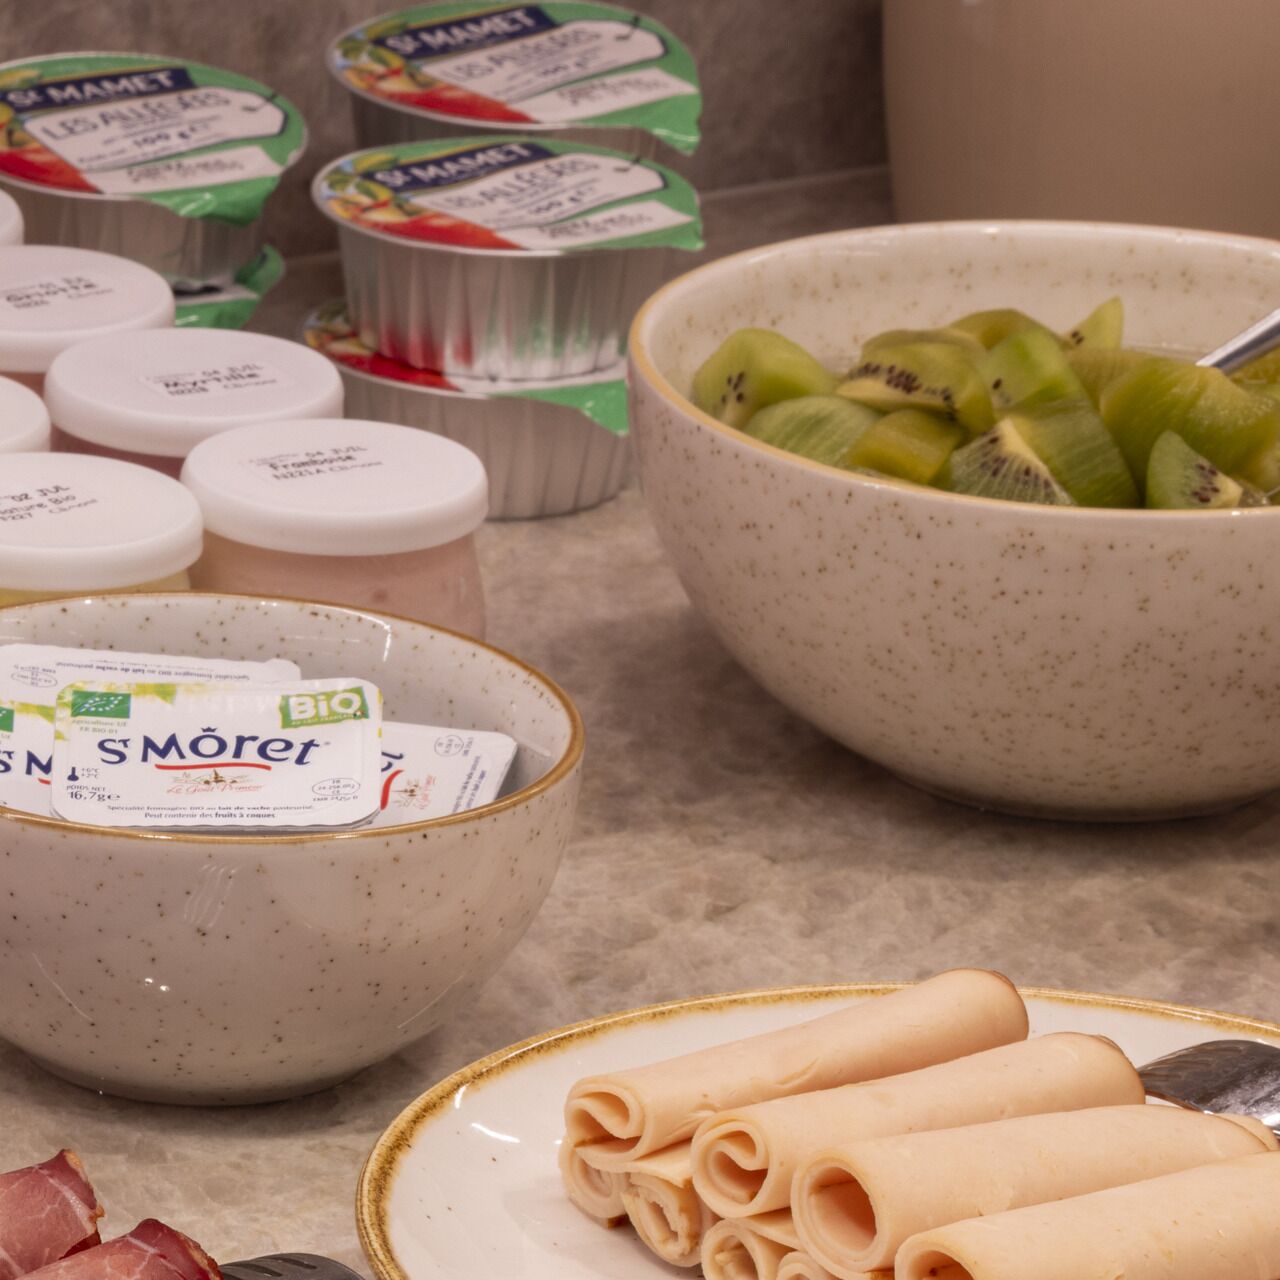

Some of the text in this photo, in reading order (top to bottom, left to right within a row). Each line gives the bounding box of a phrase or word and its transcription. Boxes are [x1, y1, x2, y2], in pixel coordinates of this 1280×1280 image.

[421, 8, 537, 50] MAMET
[46, 70, 175, 103] MAMET
[41, 116, 98, 141] LES
[412, 143, 533, 184] MAMET
[163, 373, 261, 389] Myrtille
[269, 454, 357, 472] Framboise
[11, 492, 33, 503] 02
[36, 485, 71, 498] JUL
[47, 494, 77, 505] Bio
[141, 727, 320, 766] Môret
[214, 811, 238, 819] fruits
